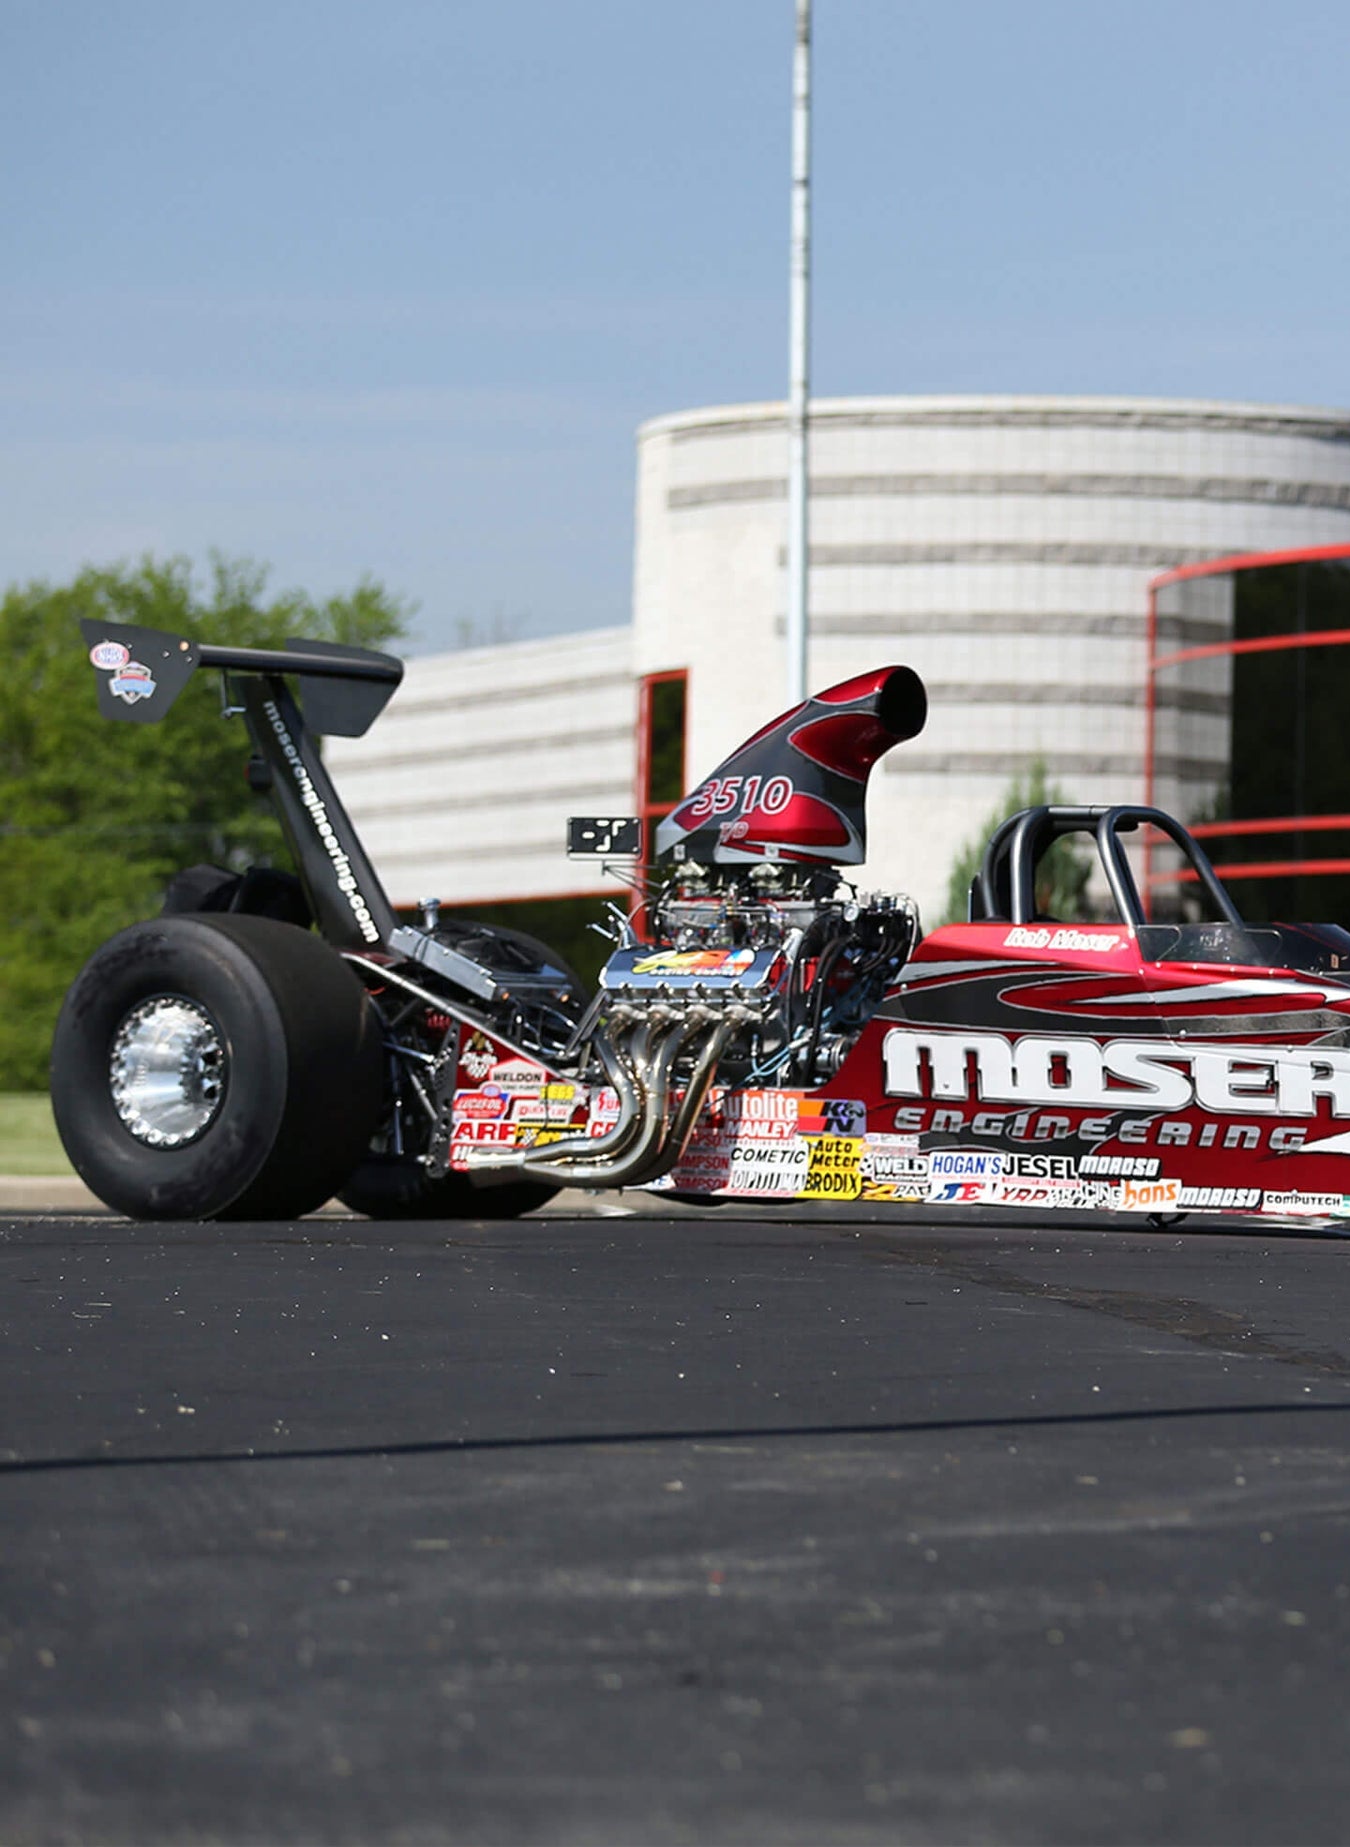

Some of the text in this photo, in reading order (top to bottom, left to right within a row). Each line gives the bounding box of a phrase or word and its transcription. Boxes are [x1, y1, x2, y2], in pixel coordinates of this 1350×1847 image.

[691, 774, 793, 816] 3510
[1003, 927, 1120, 951] Rob Moser
[493, 1071, 542, 1083] WELDON
[727, 1120, 796, 1138] MANLEY
[893, 1105, 1309, 1154] ENGINEERING
[730, 1148, 806, 1164] COMETIC
[815, 1140, 853, 1154] Auto
[811, 1154, 860, 1169] Meter
[875, 1158, 928, 1175] WELD
[932, 1156, 1002, 1174] HOGAN'S
[1002, 1156, 1078, 1180] JESEL
[805, 1173, 858, 1193] BRODIX
[932, 1182, 985, 1201] JE
[1123, 1181, 1177, 1209] hans
[1266, 1193, 1341, 1207] COMPUTECH
